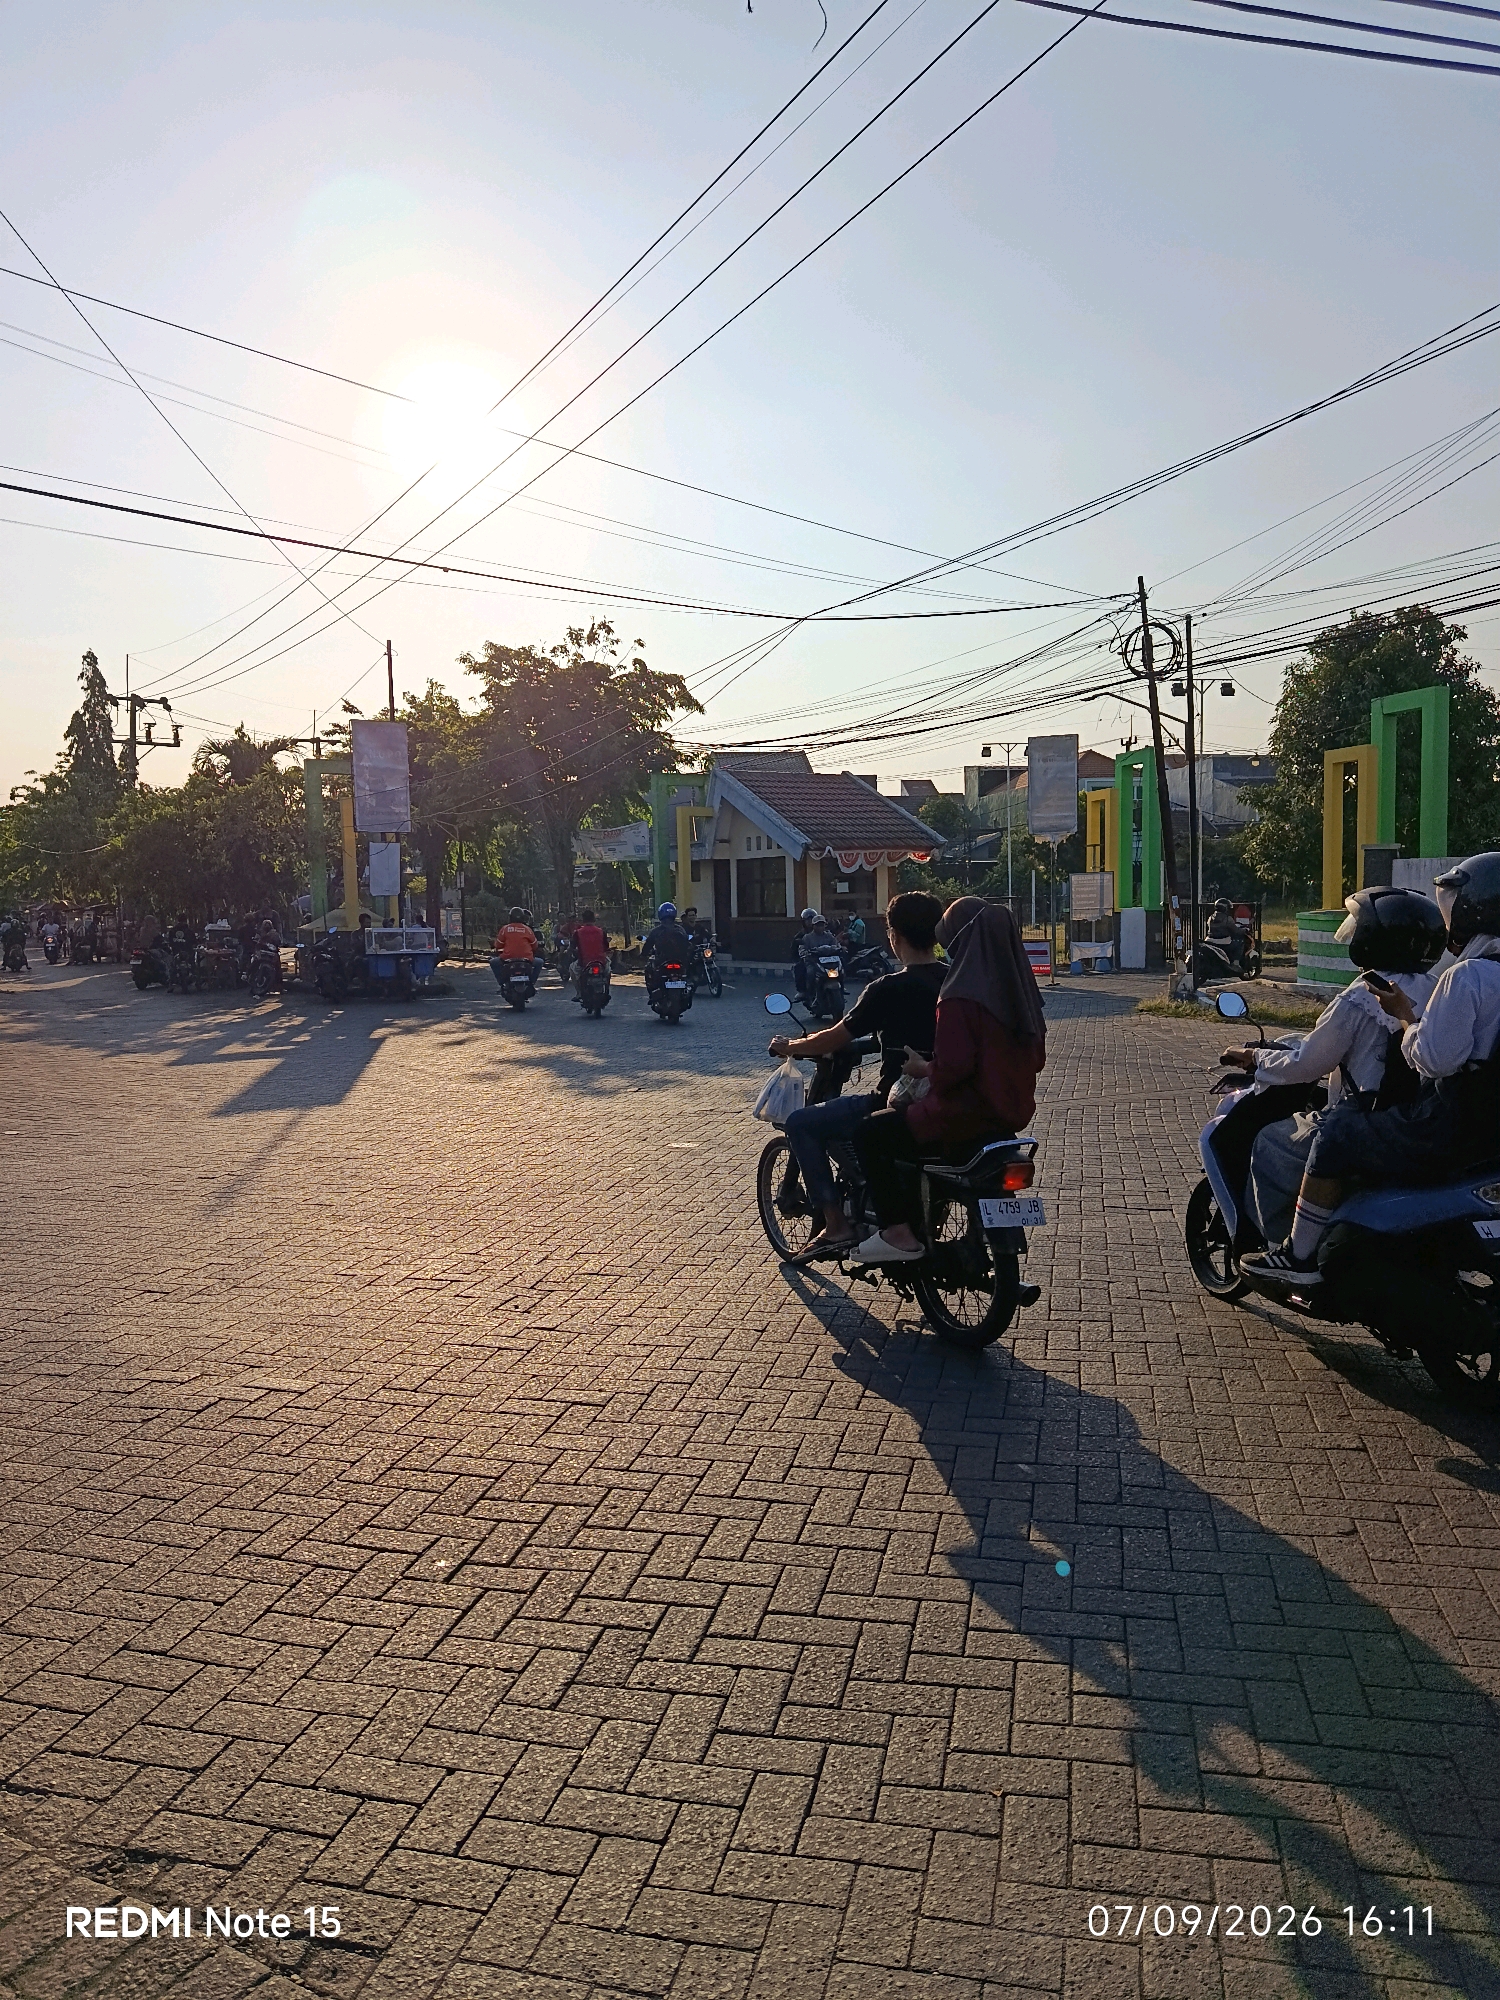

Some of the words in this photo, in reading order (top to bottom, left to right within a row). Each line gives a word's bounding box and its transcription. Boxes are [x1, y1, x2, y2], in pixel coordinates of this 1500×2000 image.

[984, 1203, 992, 1216] L
[998, 1201, 1021, 1215] 4759
[1027, 1199, 1040, 1214] JB
